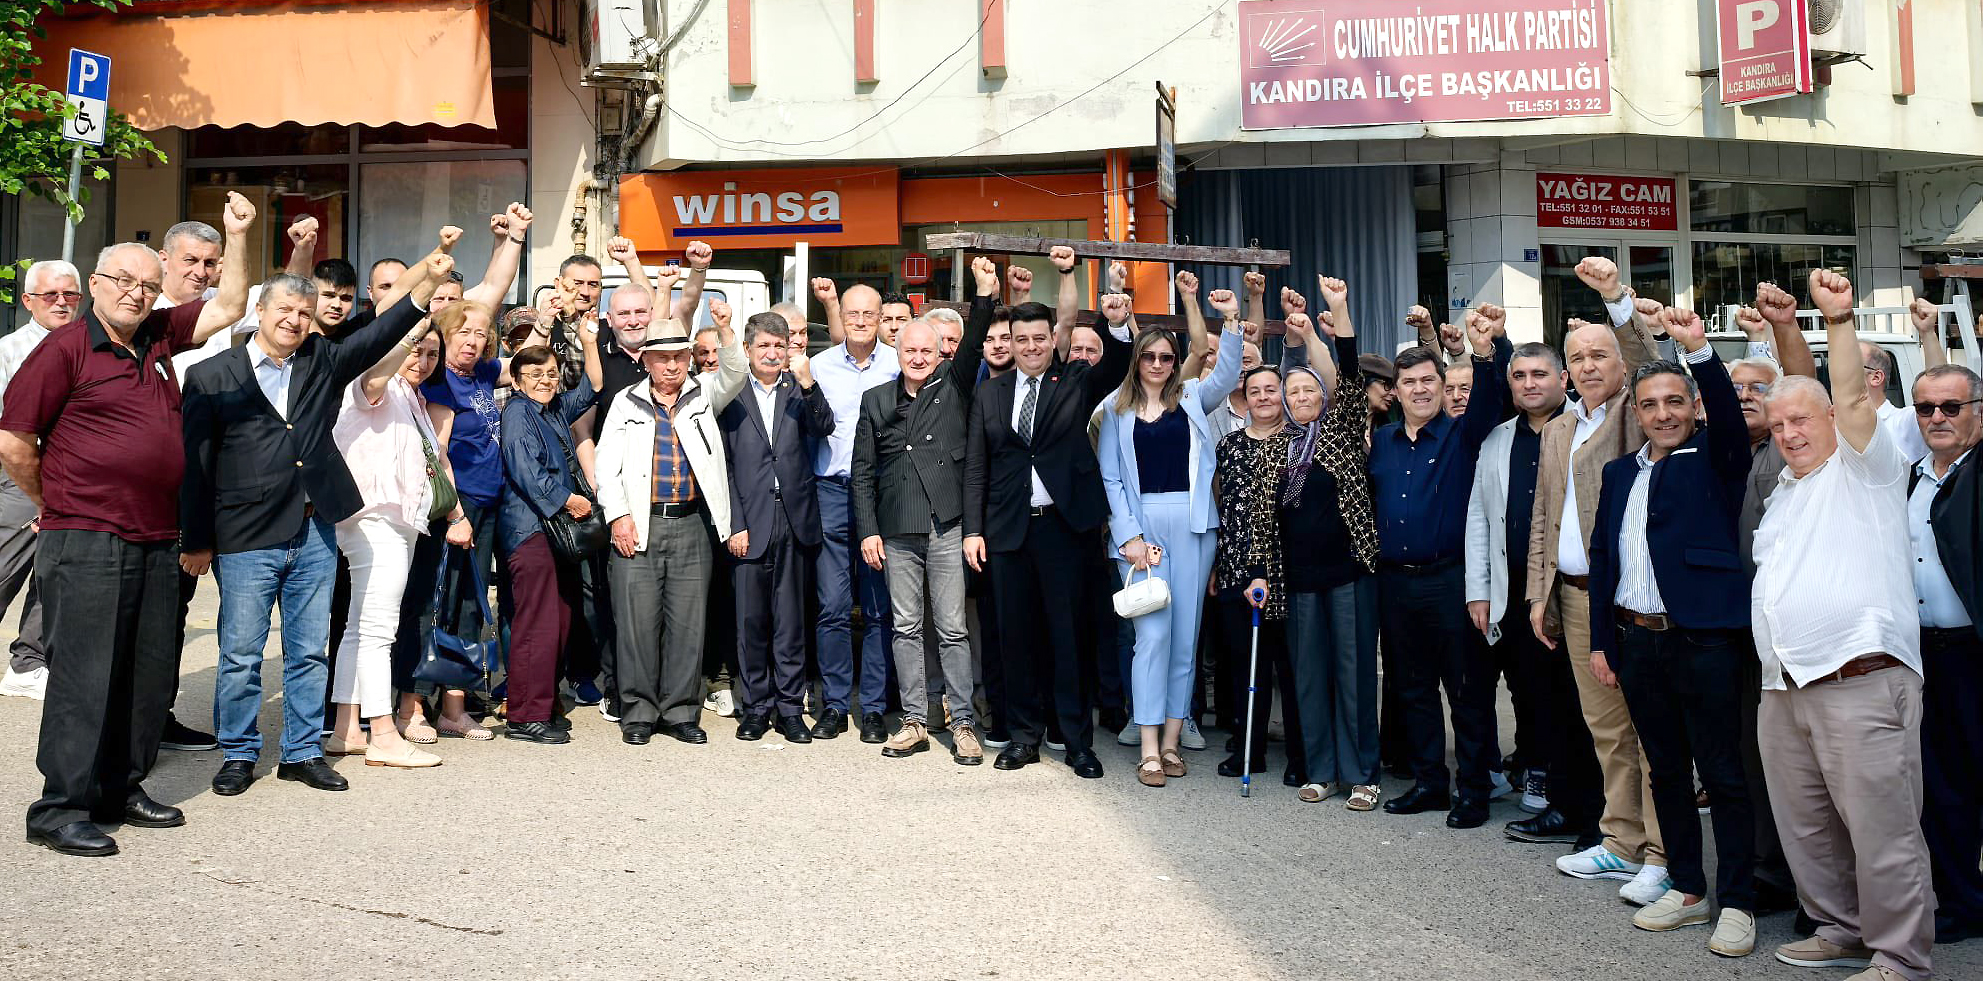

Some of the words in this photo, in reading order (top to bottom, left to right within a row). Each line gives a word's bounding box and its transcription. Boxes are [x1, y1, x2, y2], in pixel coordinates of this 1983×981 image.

[1334, 7, 1460, 60] CUMHURİYET
[1467, 12, 1519, 53] HALK
[1524, 0, 1597, 51] PARTİSİ
[1736, 0, 1780, 51] P
[79, 55, 99, 94] P
[1740, 62, 1776, 78] KANDIRA
[1250, 76, 1367, 105] KANDIRA
[1375, 70, 1433, 104] İLÇE
[1441, 62, 1601, 100] BAŞKANLIĞI
[1726, 80, 1743, 96] İLÇE
[1745, 71, 1794, 92] BAŞKANLIĞI
[1506, 100, 1560, 113] TEL:551
[1565, 99, 1581, 111] 33
[1585, 98, 1601, 110] 22
[673, 181, 840, 224] winsa
[1539, 177, 1613, 201] YAĞIZ
[1620, 183, 1671, 203] CAM
[1540, 202, 1576, 213] TEL:551
[1578, 204, 1590, 213] 32
[1592, 204, 1602, 213] 01
[1610, 205, 1645, 215] FAX:551
[1648, 206, 1659, 215] 53
[1660, 206, 1670, 215] 51
[1562, 215, 1606, 225] GSM:0537
[1609, 217, 1625, 226] 938
[1627, 218, 1638, 227] 34
[1640, 218, 1650, 227] 51
